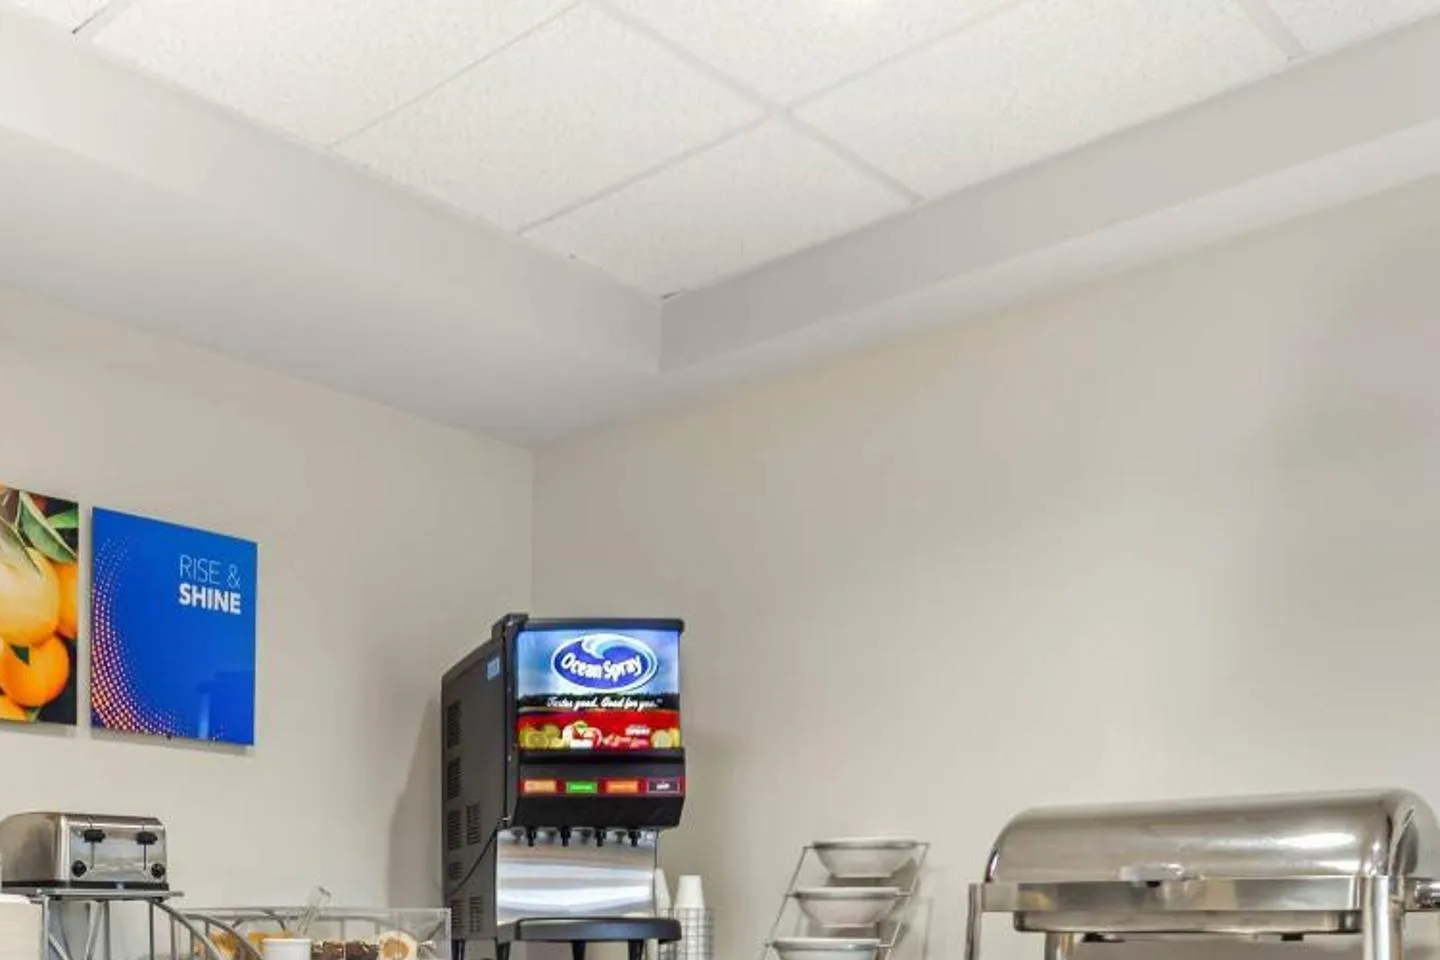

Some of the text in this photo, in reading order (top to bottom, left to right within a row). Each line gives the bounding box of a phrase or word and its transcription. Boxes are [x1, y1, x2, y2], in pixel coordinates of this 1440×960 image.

[179, 553, 241, 589] RISE &
[179, 582, 242, 616] SHINE
[561, 652, 642, 682] Ocean Spray
